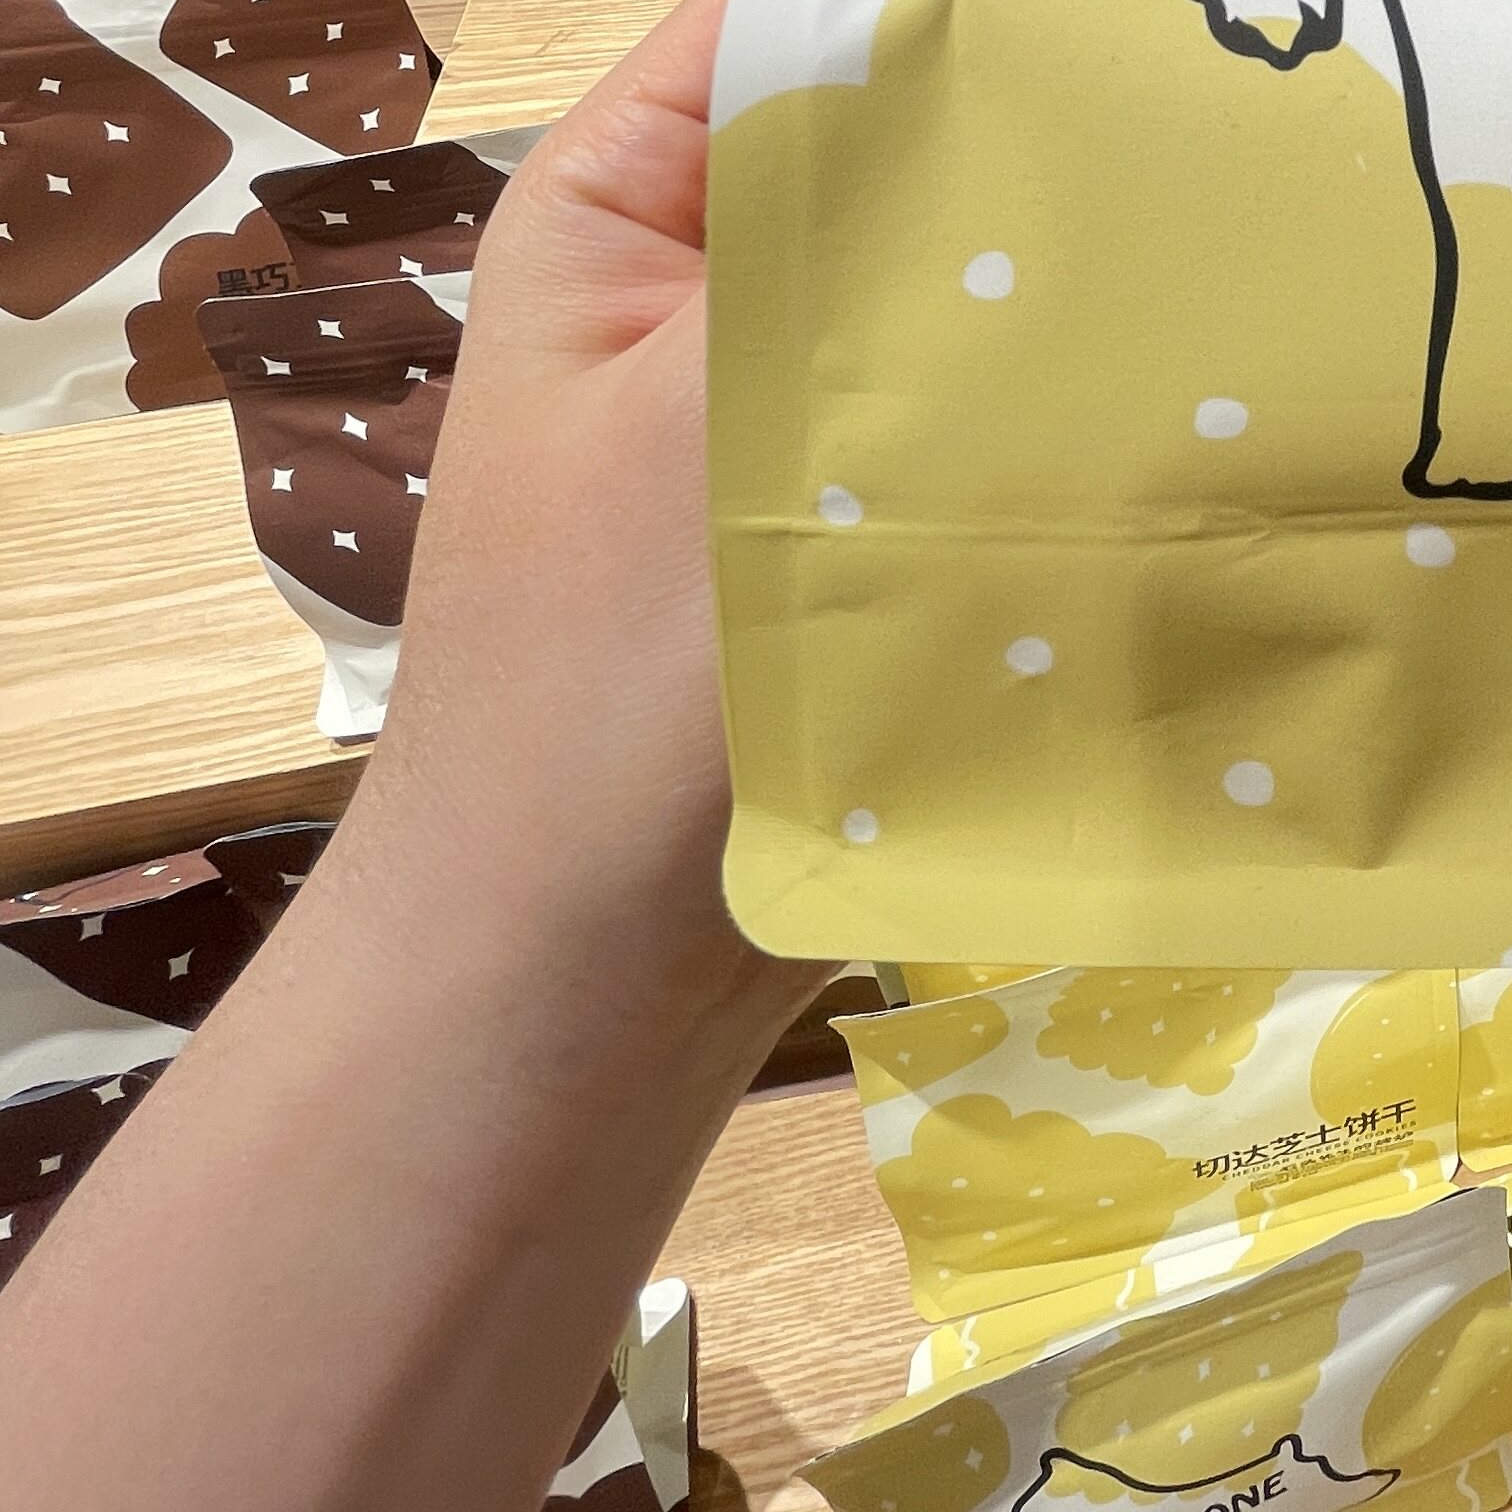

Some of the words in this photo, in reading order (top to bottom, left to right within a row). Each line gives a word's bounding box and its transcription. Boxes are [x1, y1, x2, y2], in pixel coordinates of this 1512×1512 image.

[1193, 1099, 1416, 1179] 切达芝士饼干
[1222, 1157, 1290, 1181] CHEDDAR
[1296, 1140, 1350, 1160] CHEESE
